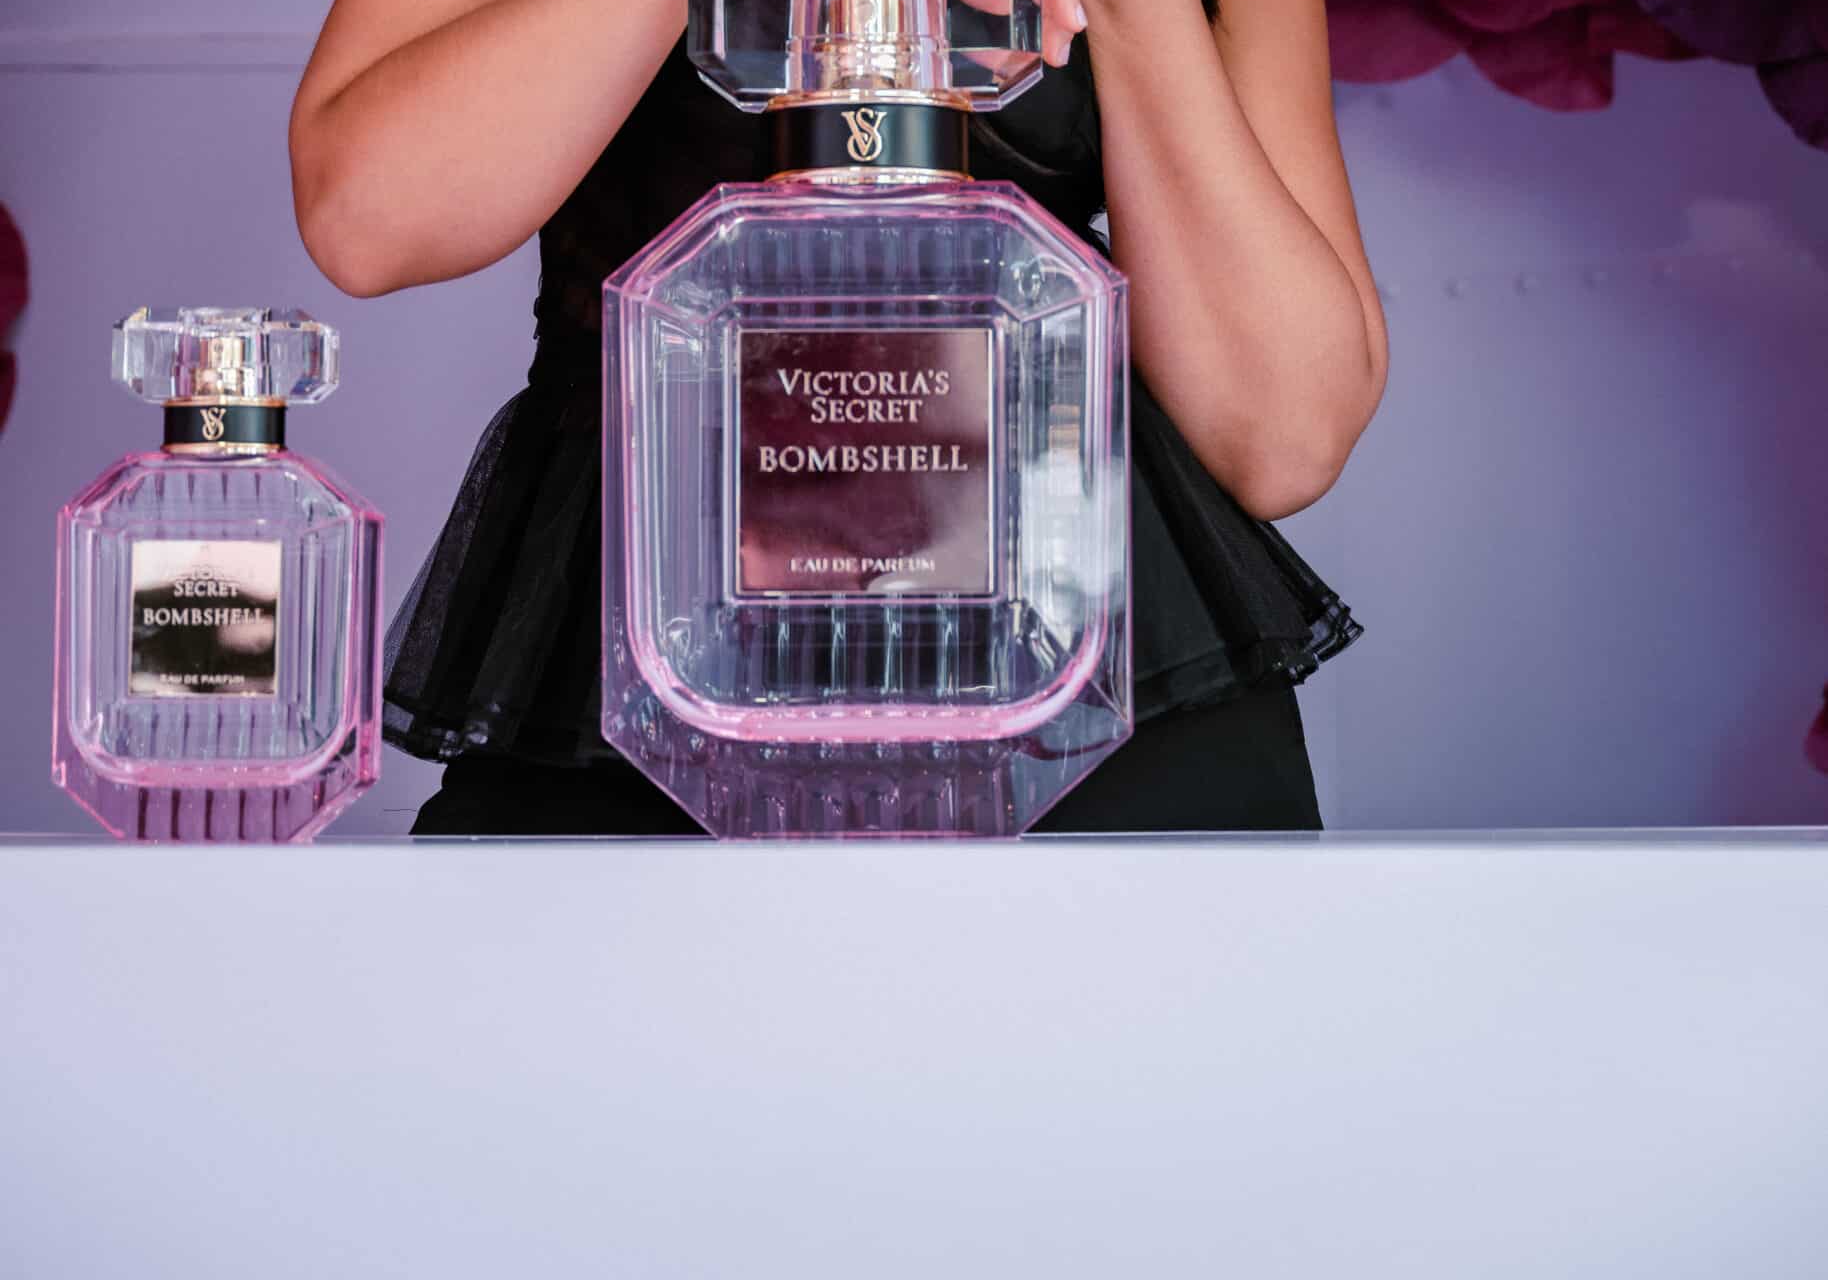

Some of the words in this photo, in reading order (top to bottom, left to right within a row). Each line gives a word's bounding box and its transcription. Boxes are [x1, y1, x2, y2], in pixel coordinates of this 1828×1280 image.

[776, 368, 951, 396] VICTORIA'S
[810, 396, 924, 424] SECRET
[758, 445, 969, 473] BOMBSHELL
[789, 557, 829, 573] EAU
[831, 557, 858, 573] DE
[861, 557, 936, 573] PARFUM
[173, 579, 240, 598] SECRET
[142, 607, 263, 626] BOMBSHELL
[183, 673, 199, 685] DE
